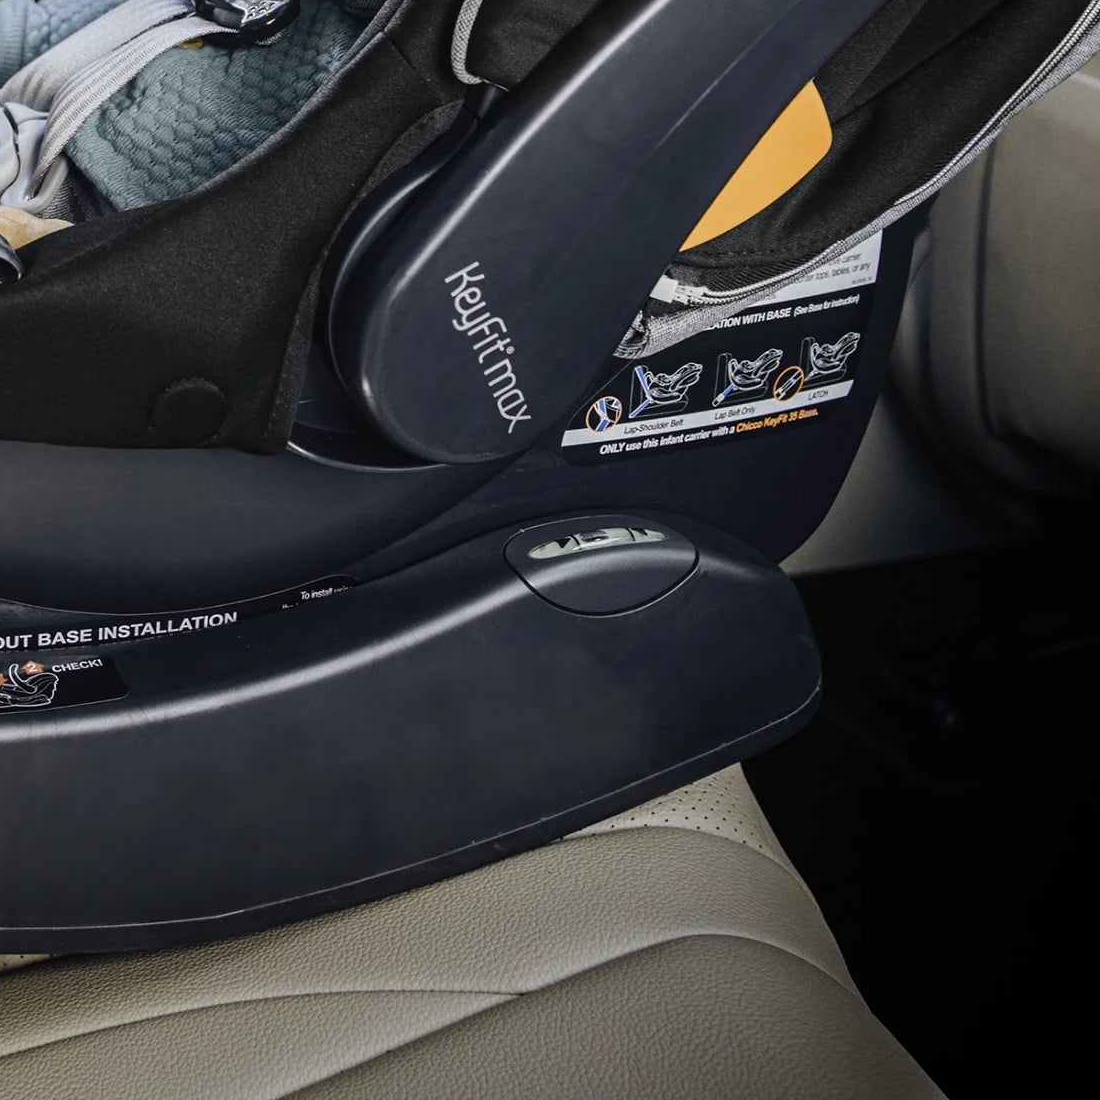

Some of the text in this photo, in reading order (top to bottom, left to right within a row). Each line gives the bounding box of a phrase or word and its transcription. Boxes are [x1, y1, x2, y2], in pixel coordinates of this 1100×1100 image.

[742, 312, 766, 324] WITH
[766, 307, 792, 320] BASE
[483, 358, 532, 434] max
[808, 390, 829, 400] LATCH
[714, 406, 756, 420] Lap Belt Only
[600, 442, 626, 454] ONLY
[626, 442, 640, 451] use
[642, 438, 659, 448] this
[660, 434, 684, 446] infant
[684, 430, 711, 442] carrier
[712, 426, 729, 437] with
[736, 420, 763, 433] Chicco
[764, 414, 788, 428] KeyFit
[624, 419, 684, 434] Lap-Shoulder Belt
[300, 590, 310, 600] To
[311, 587, 334, 598] install
[38, 629, 92, 646] BASE
[98, 612, 238, 640] INSTALLATION
[52, 658, 104, 674] CHECK!
